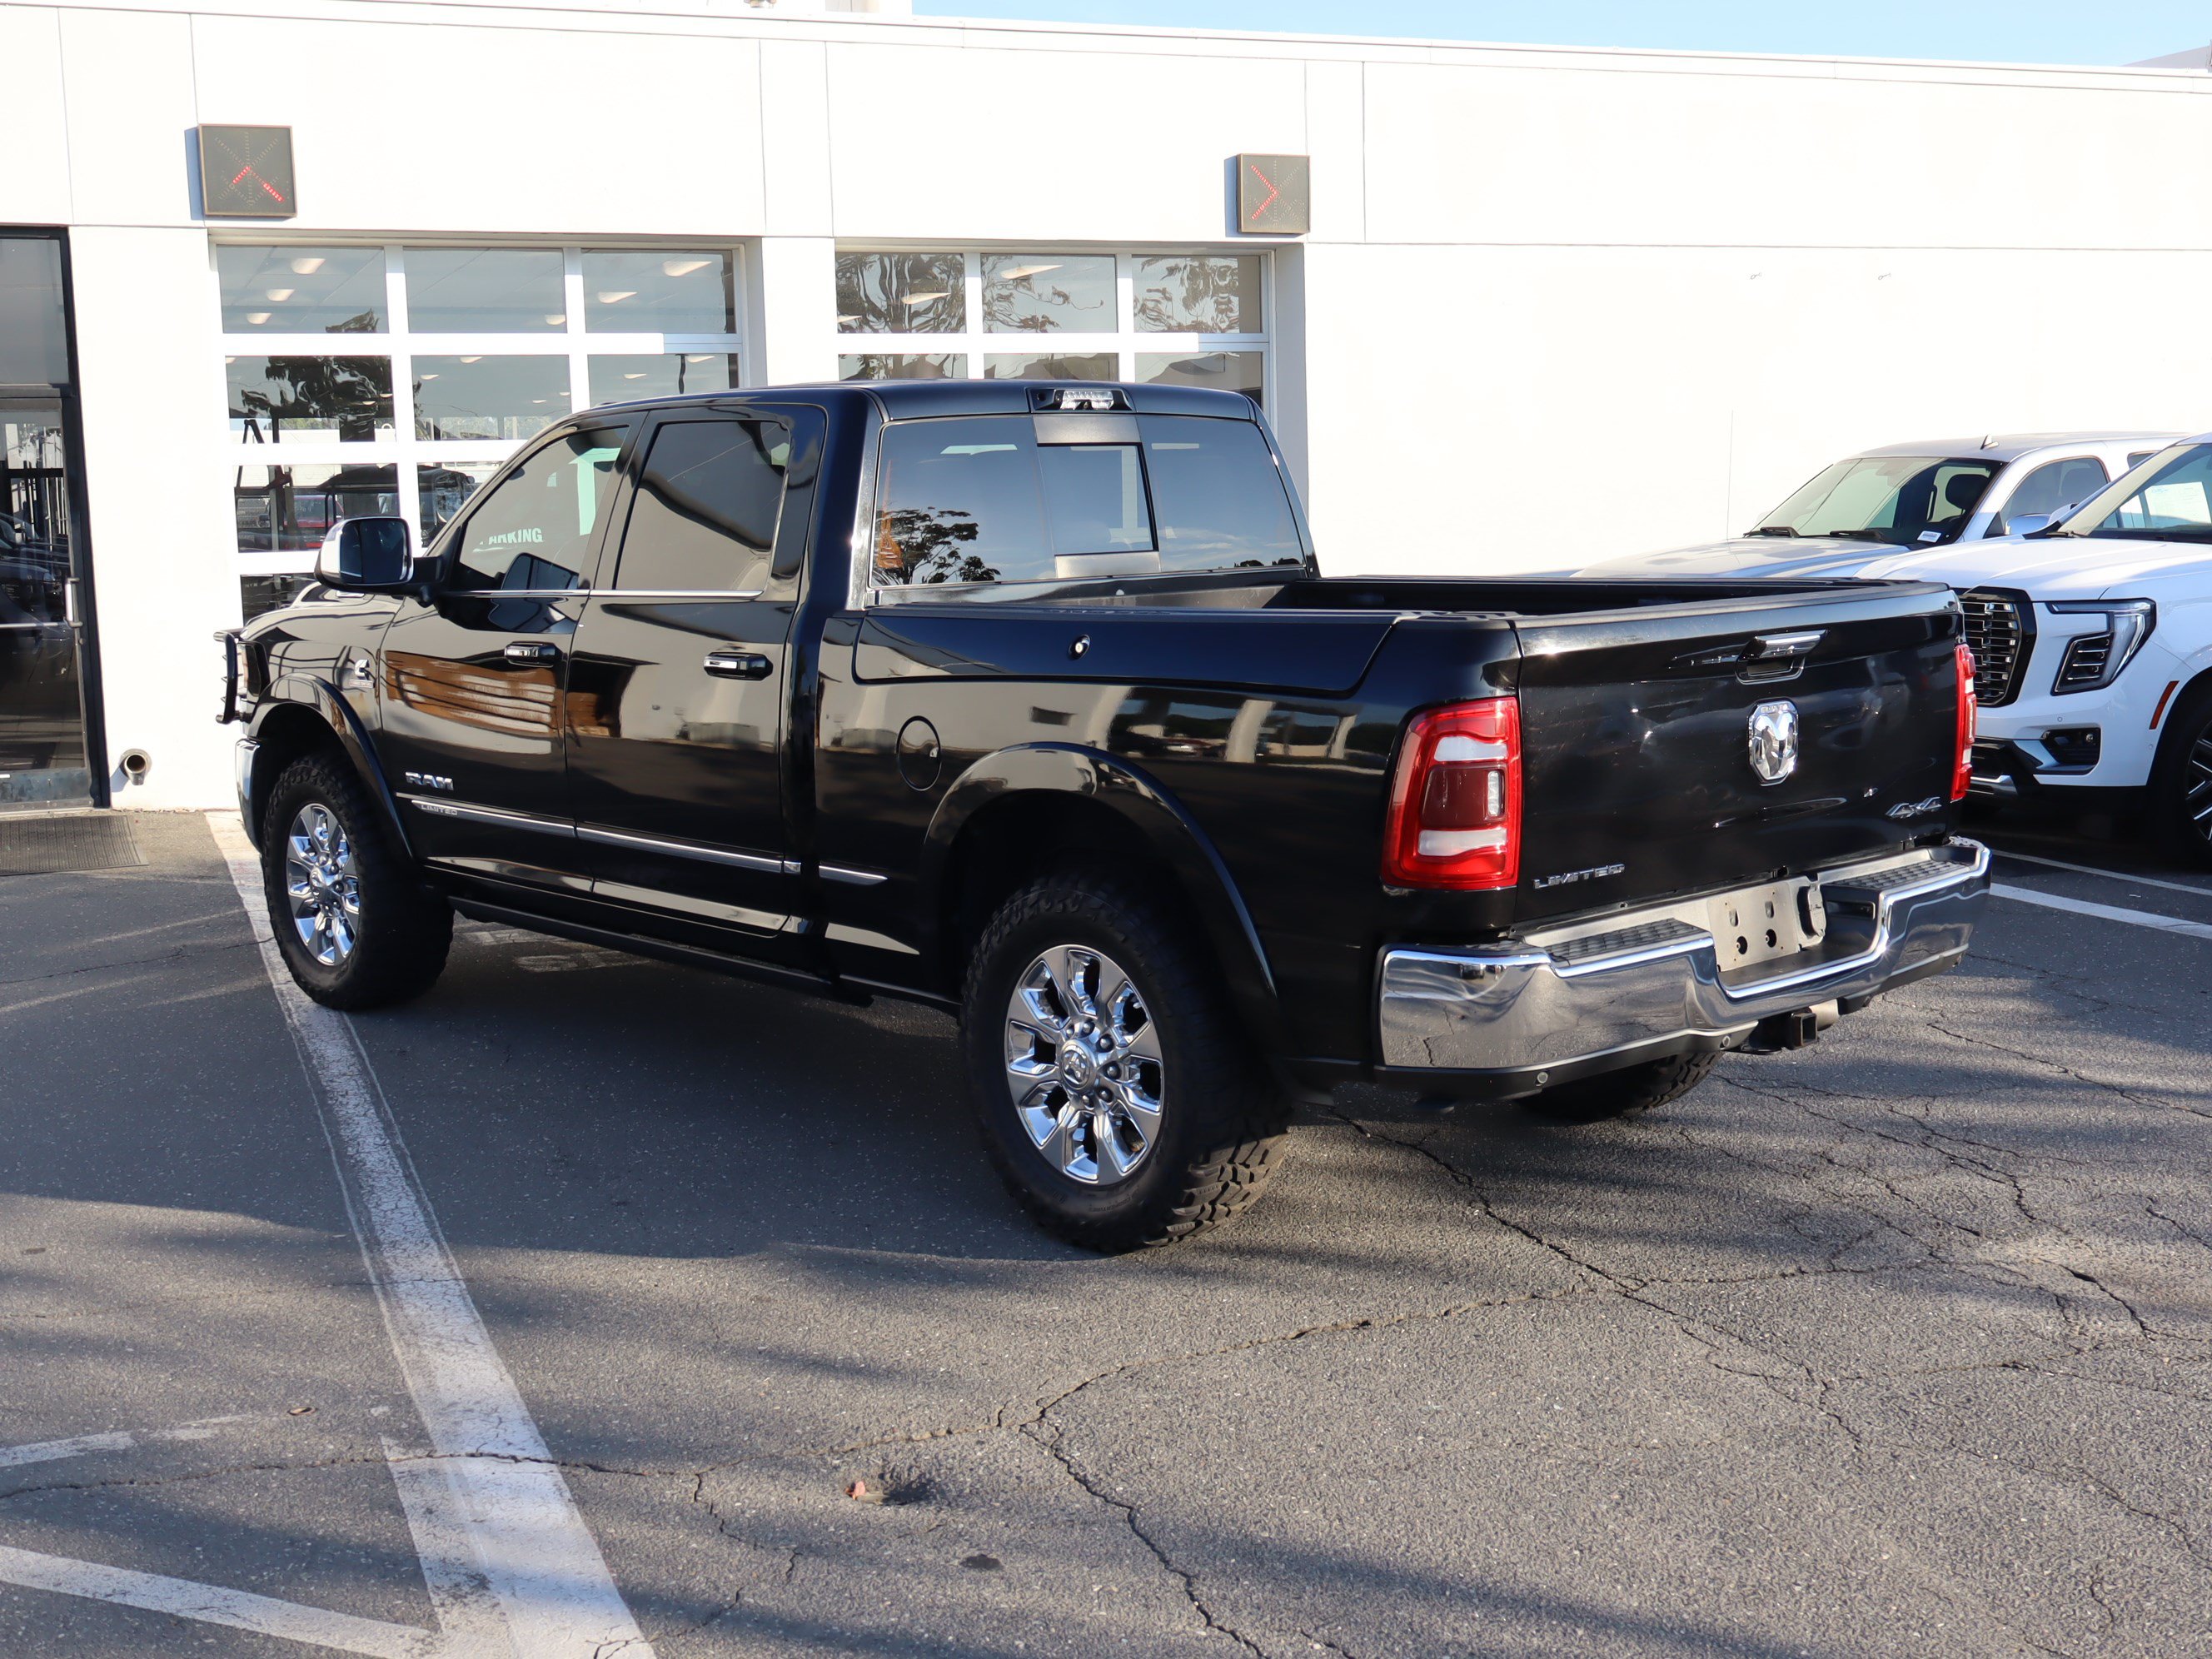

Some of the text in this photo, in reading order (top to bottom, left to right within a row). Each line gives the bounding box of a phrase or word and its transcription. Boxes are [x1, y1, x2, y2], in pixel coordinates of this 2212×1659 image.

[480, 527, 544, 546] ARKING
[405, 771, 454, 790] RAM
[421, 805, 457, 815] LIMITED
[1532, 864, 1625, 889] LIMITED
